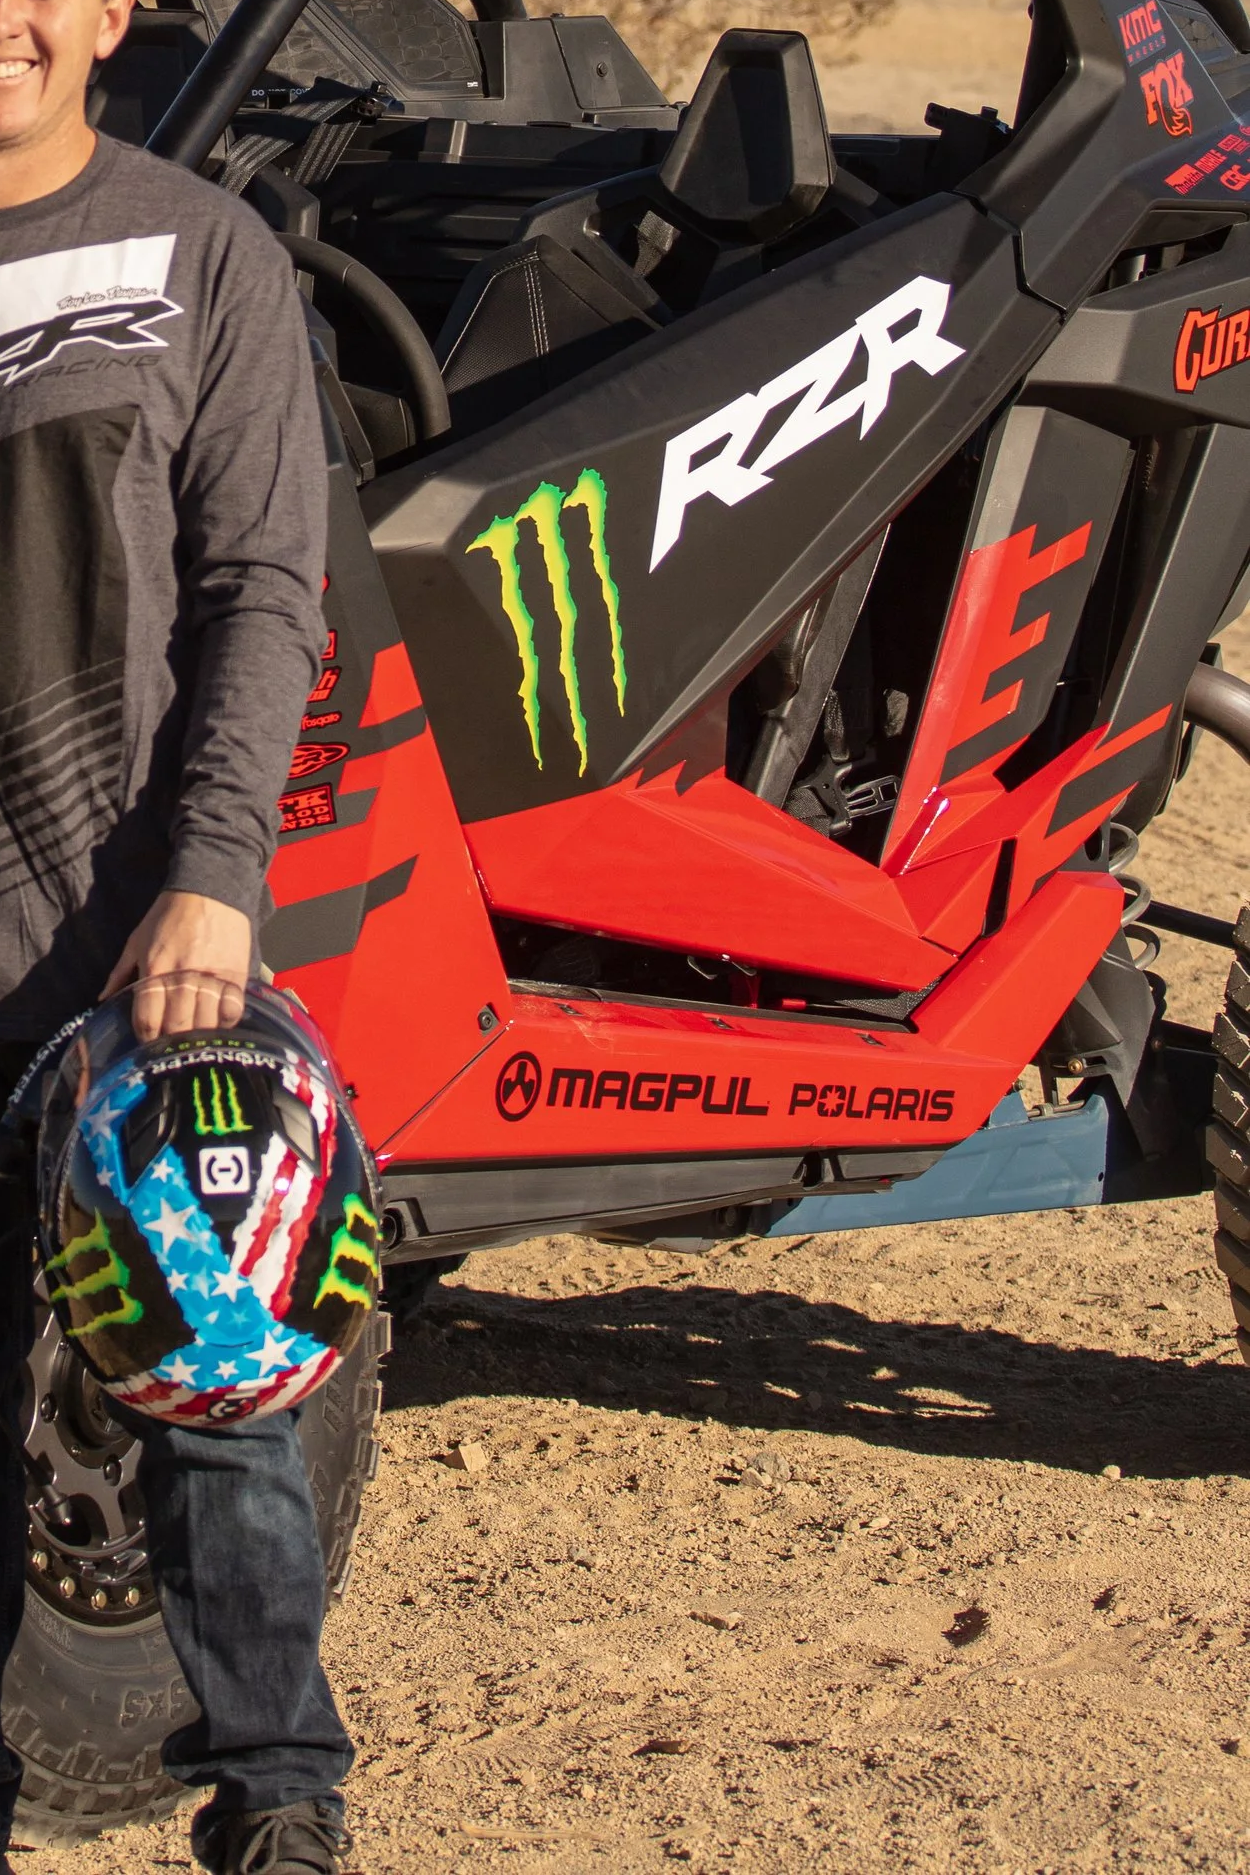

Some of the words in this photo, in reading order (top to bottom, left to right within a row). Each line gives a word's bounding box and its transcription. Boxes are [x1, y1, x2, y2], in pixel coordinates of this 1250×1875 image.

[1127, 35, 1167, 63] WHEELS
[251, 89, 265, 97] DO
[1139, 51, 1193, 136] FOX
[1173, 306, 1250, 393] CUR
[7, 354, 163, 394] RACING
[649, 275, 966, 575] RZR
[7, 1007, 94, 1103] MONSTER
[151, 1050, 277, 1074] MONSTER
[546, 1067, 769, 1116] MAGPUL
[788, 1082, 955, 1123] POLARIS
